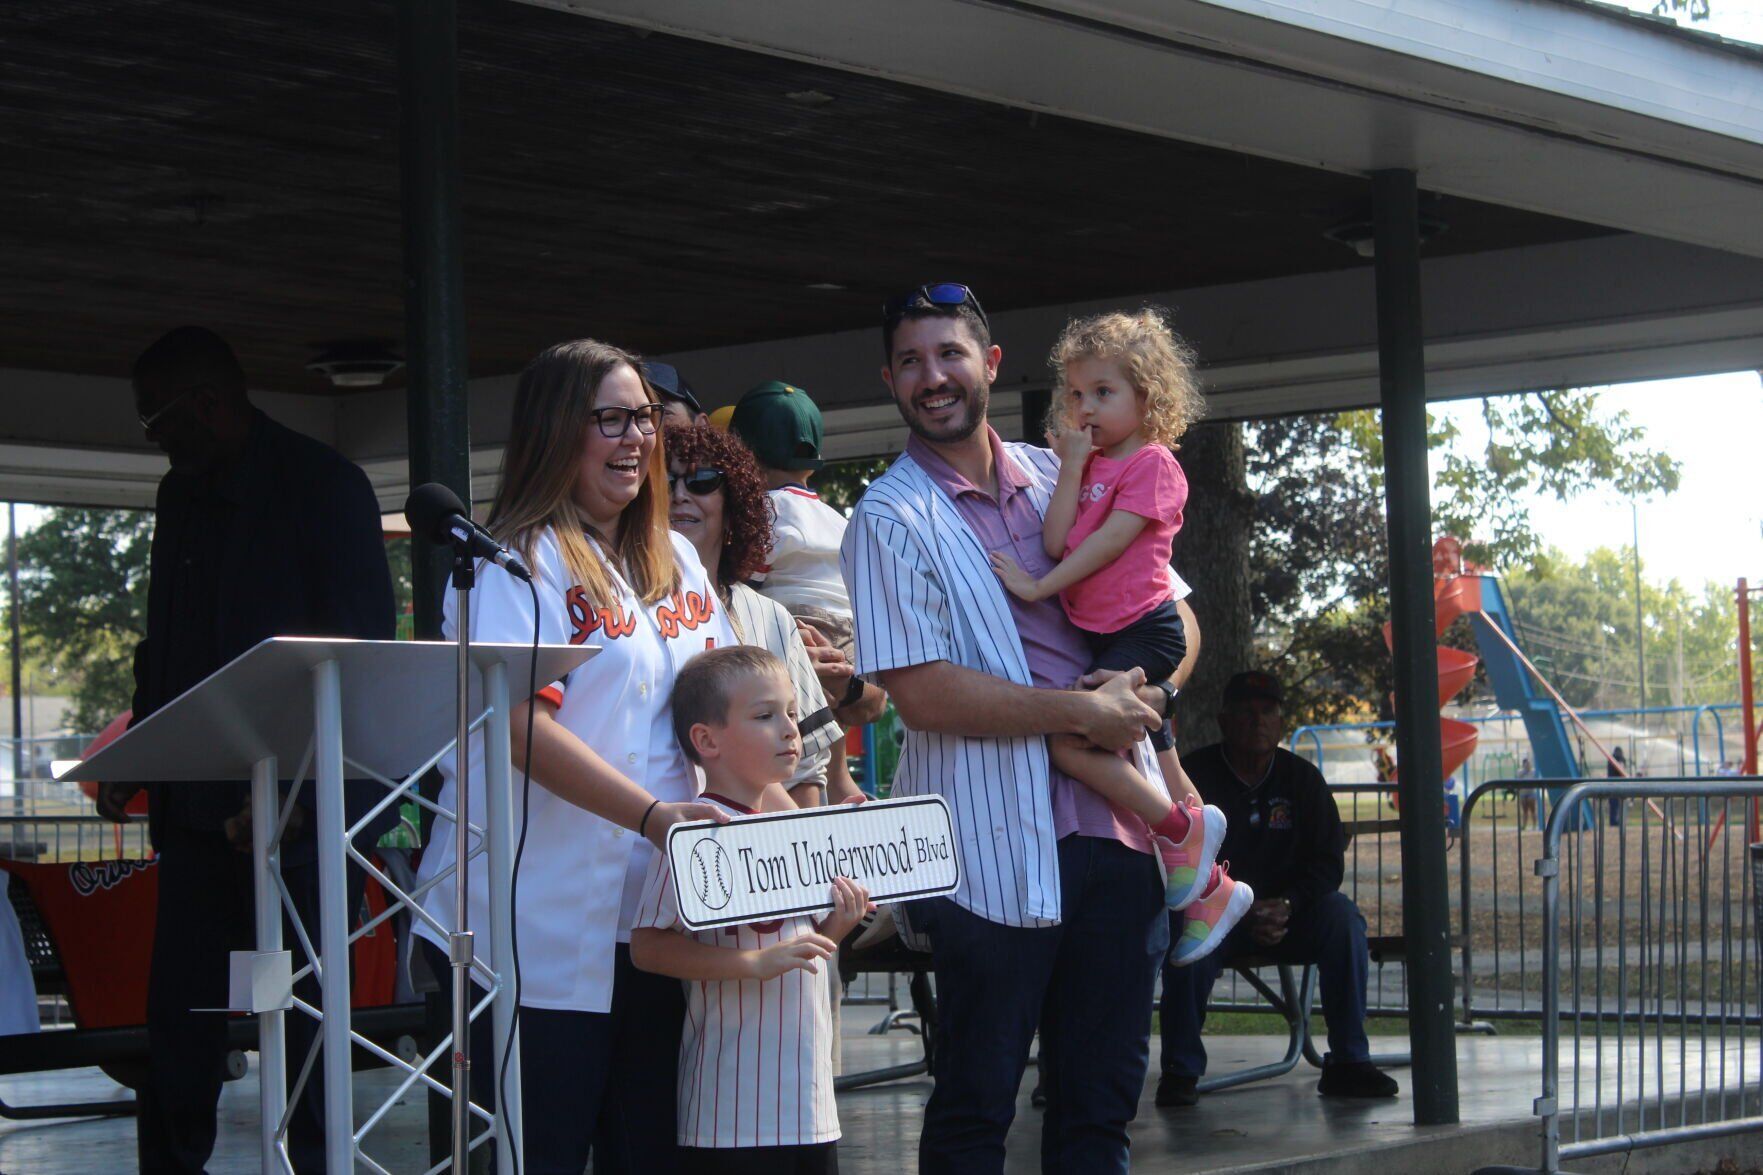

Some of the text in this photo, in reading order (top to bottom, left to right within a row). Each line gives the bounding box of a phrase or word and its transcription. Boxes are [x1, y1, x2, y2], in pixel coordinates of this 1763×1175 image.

[738, 825, 949, 894] Tom Underwood Blvd
